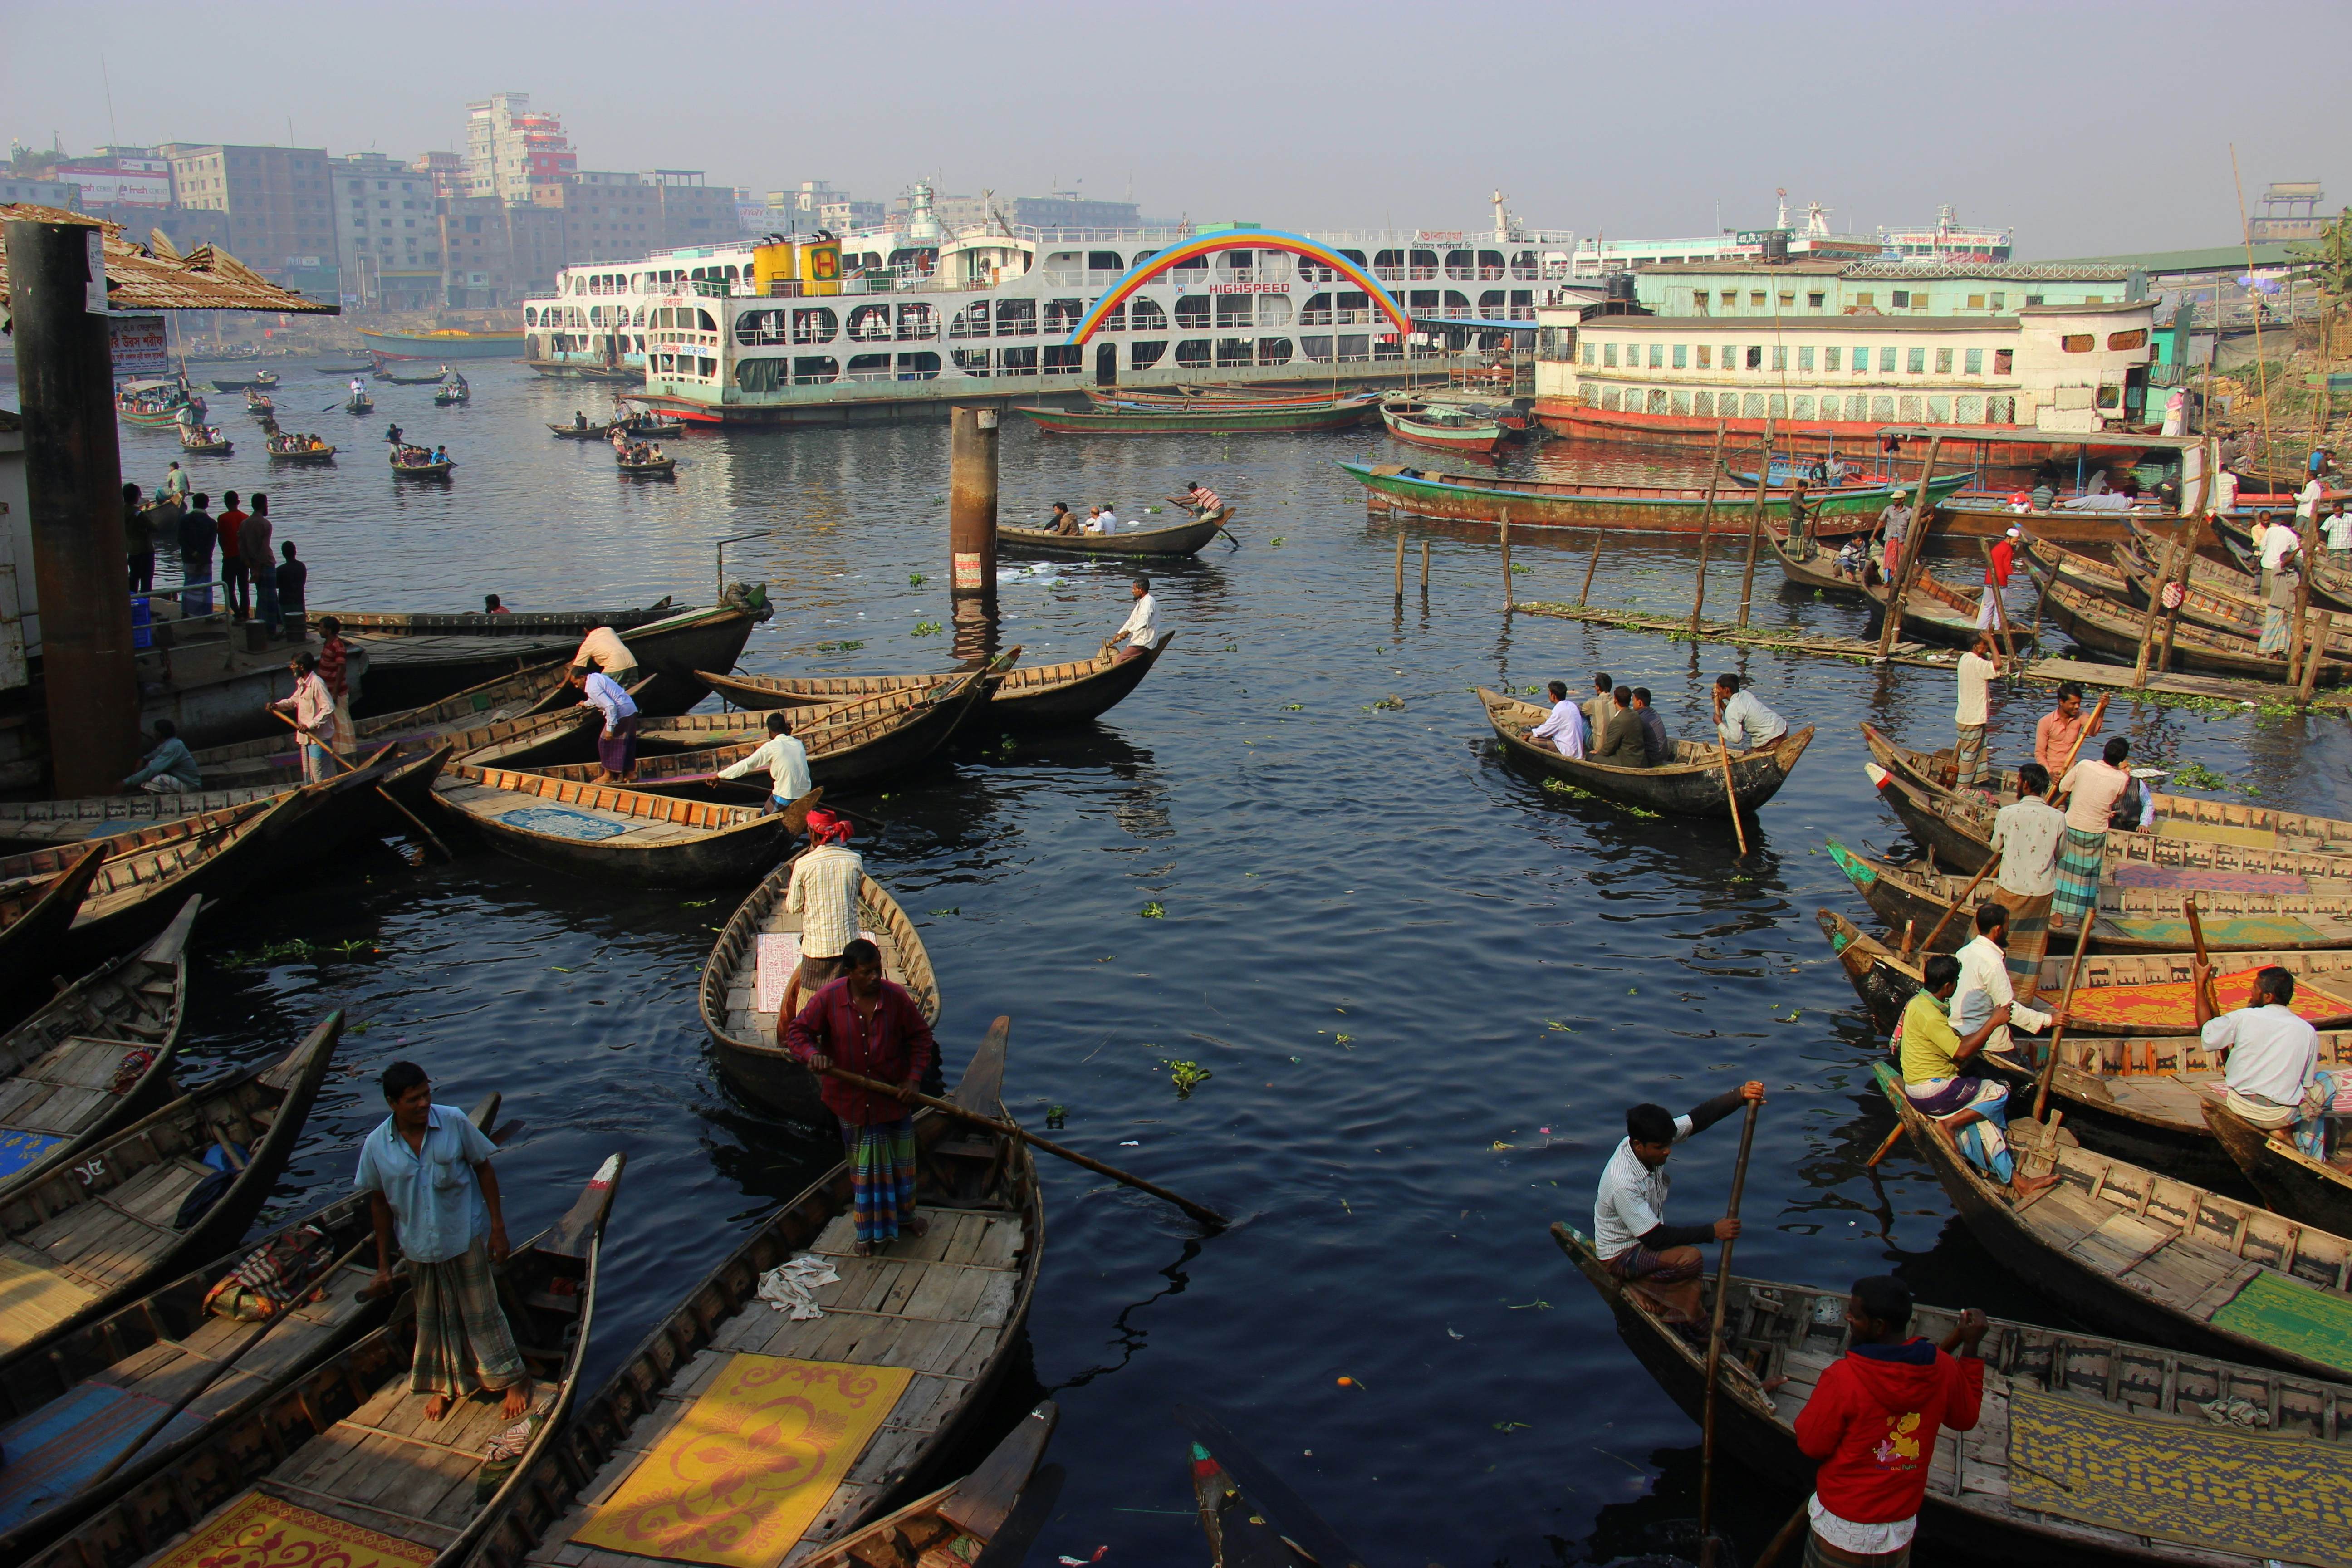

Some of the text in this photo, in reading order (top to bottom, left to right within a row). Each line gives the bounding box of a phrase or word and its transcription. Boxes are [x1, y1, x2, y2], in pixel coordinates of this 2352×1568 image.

[80, 183, 95, 192] resh
[129, 185, 148, 194] Fresh
[817, 253, 835, 275] H
[1210, 283, 1289, 294] HIGHSPEED
[121, 334, 140, 348] উরস
[142, 332, 163, 347] শরীফ
